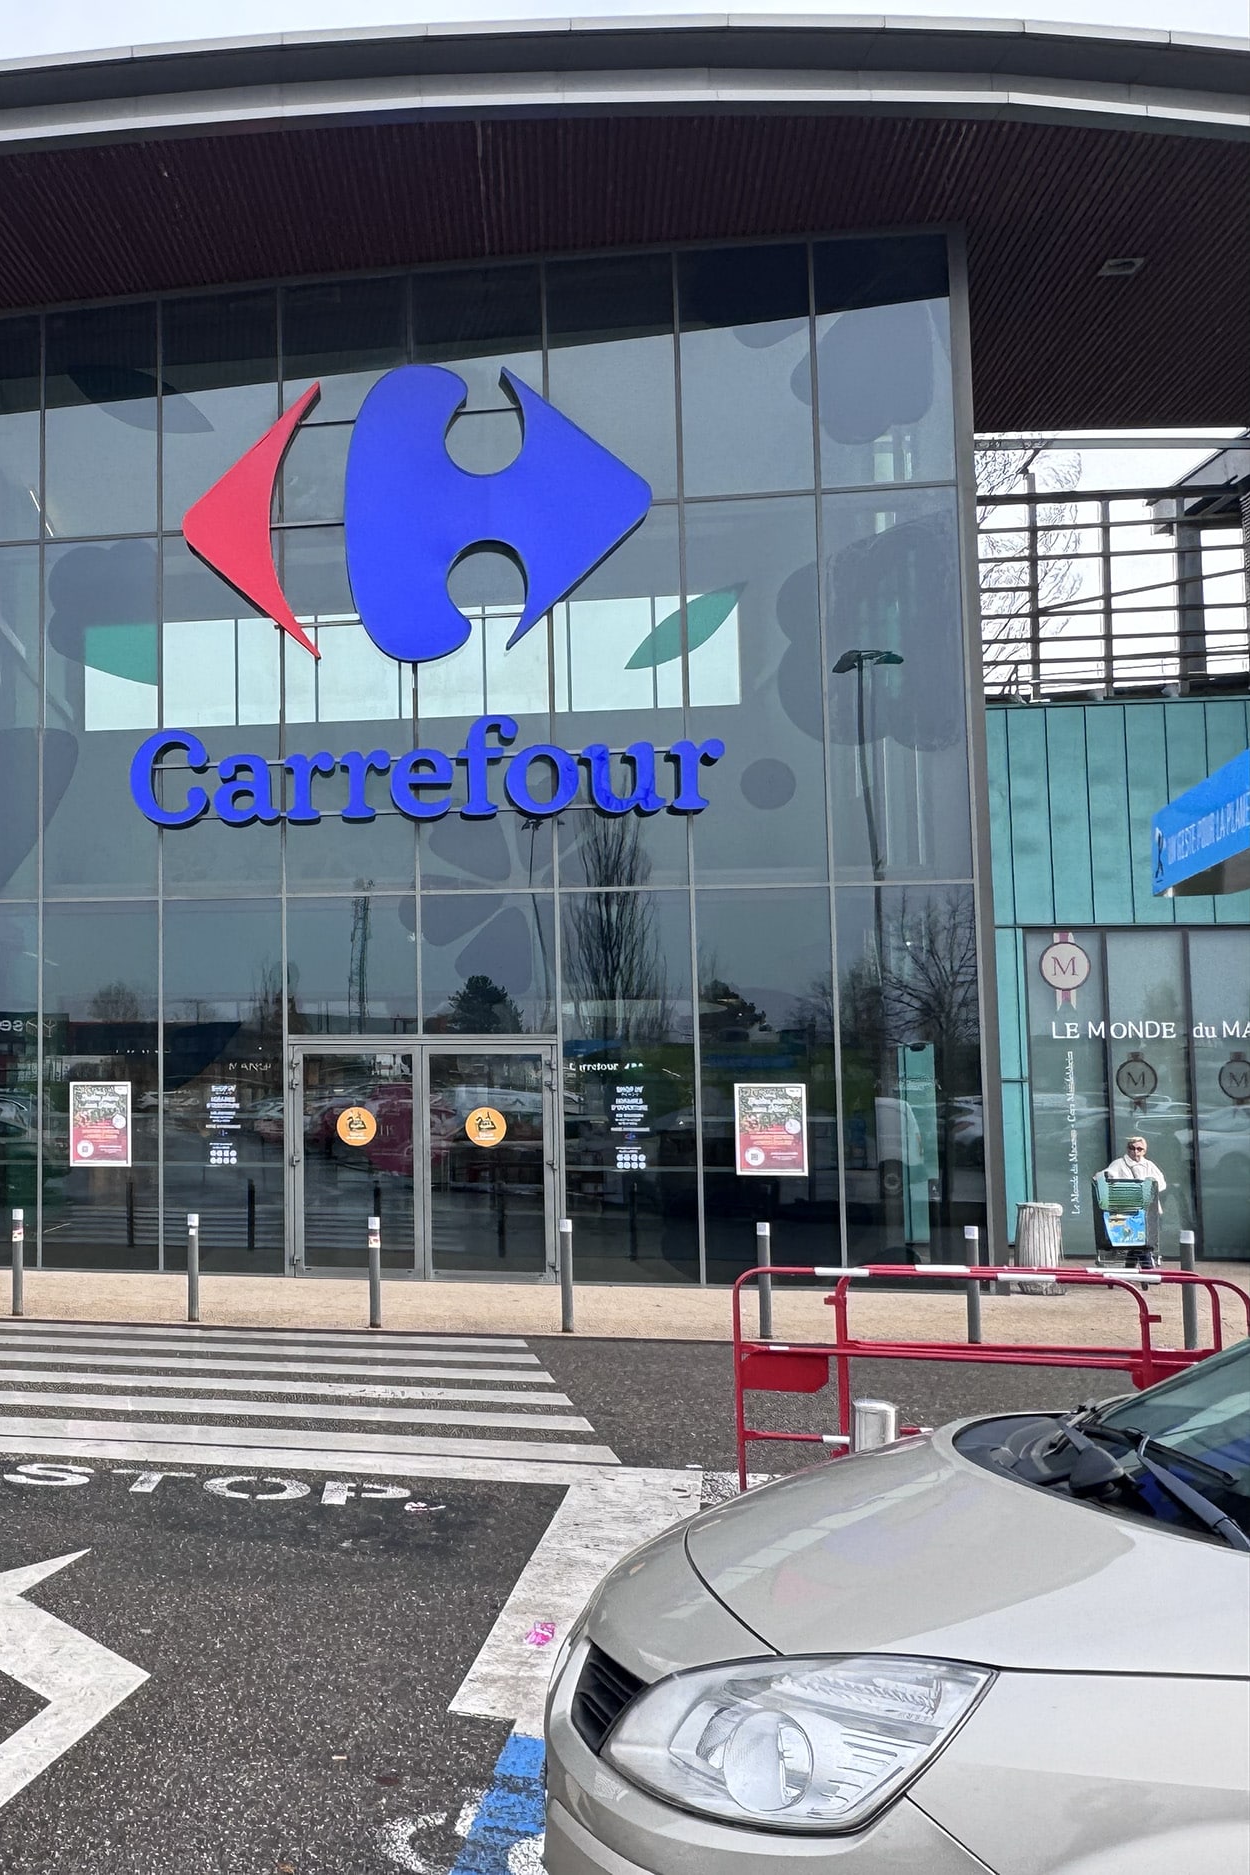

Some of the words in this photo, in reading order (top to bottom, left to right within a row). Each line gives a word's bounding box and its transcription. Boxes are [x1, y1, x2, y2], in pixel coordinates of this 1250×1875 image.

[130, 714, 725, 826] Carrefour
[1050, 956, 1079, 977] M
[1052, 1021, 1080, 1039] LE
[1088, 1020, 1177, 1039] MONDE
[1193, 1022, 1218, 1039] du
[1126, 1071, 1145, 1088] M
[2, 1462, 412, 1505] STOP
